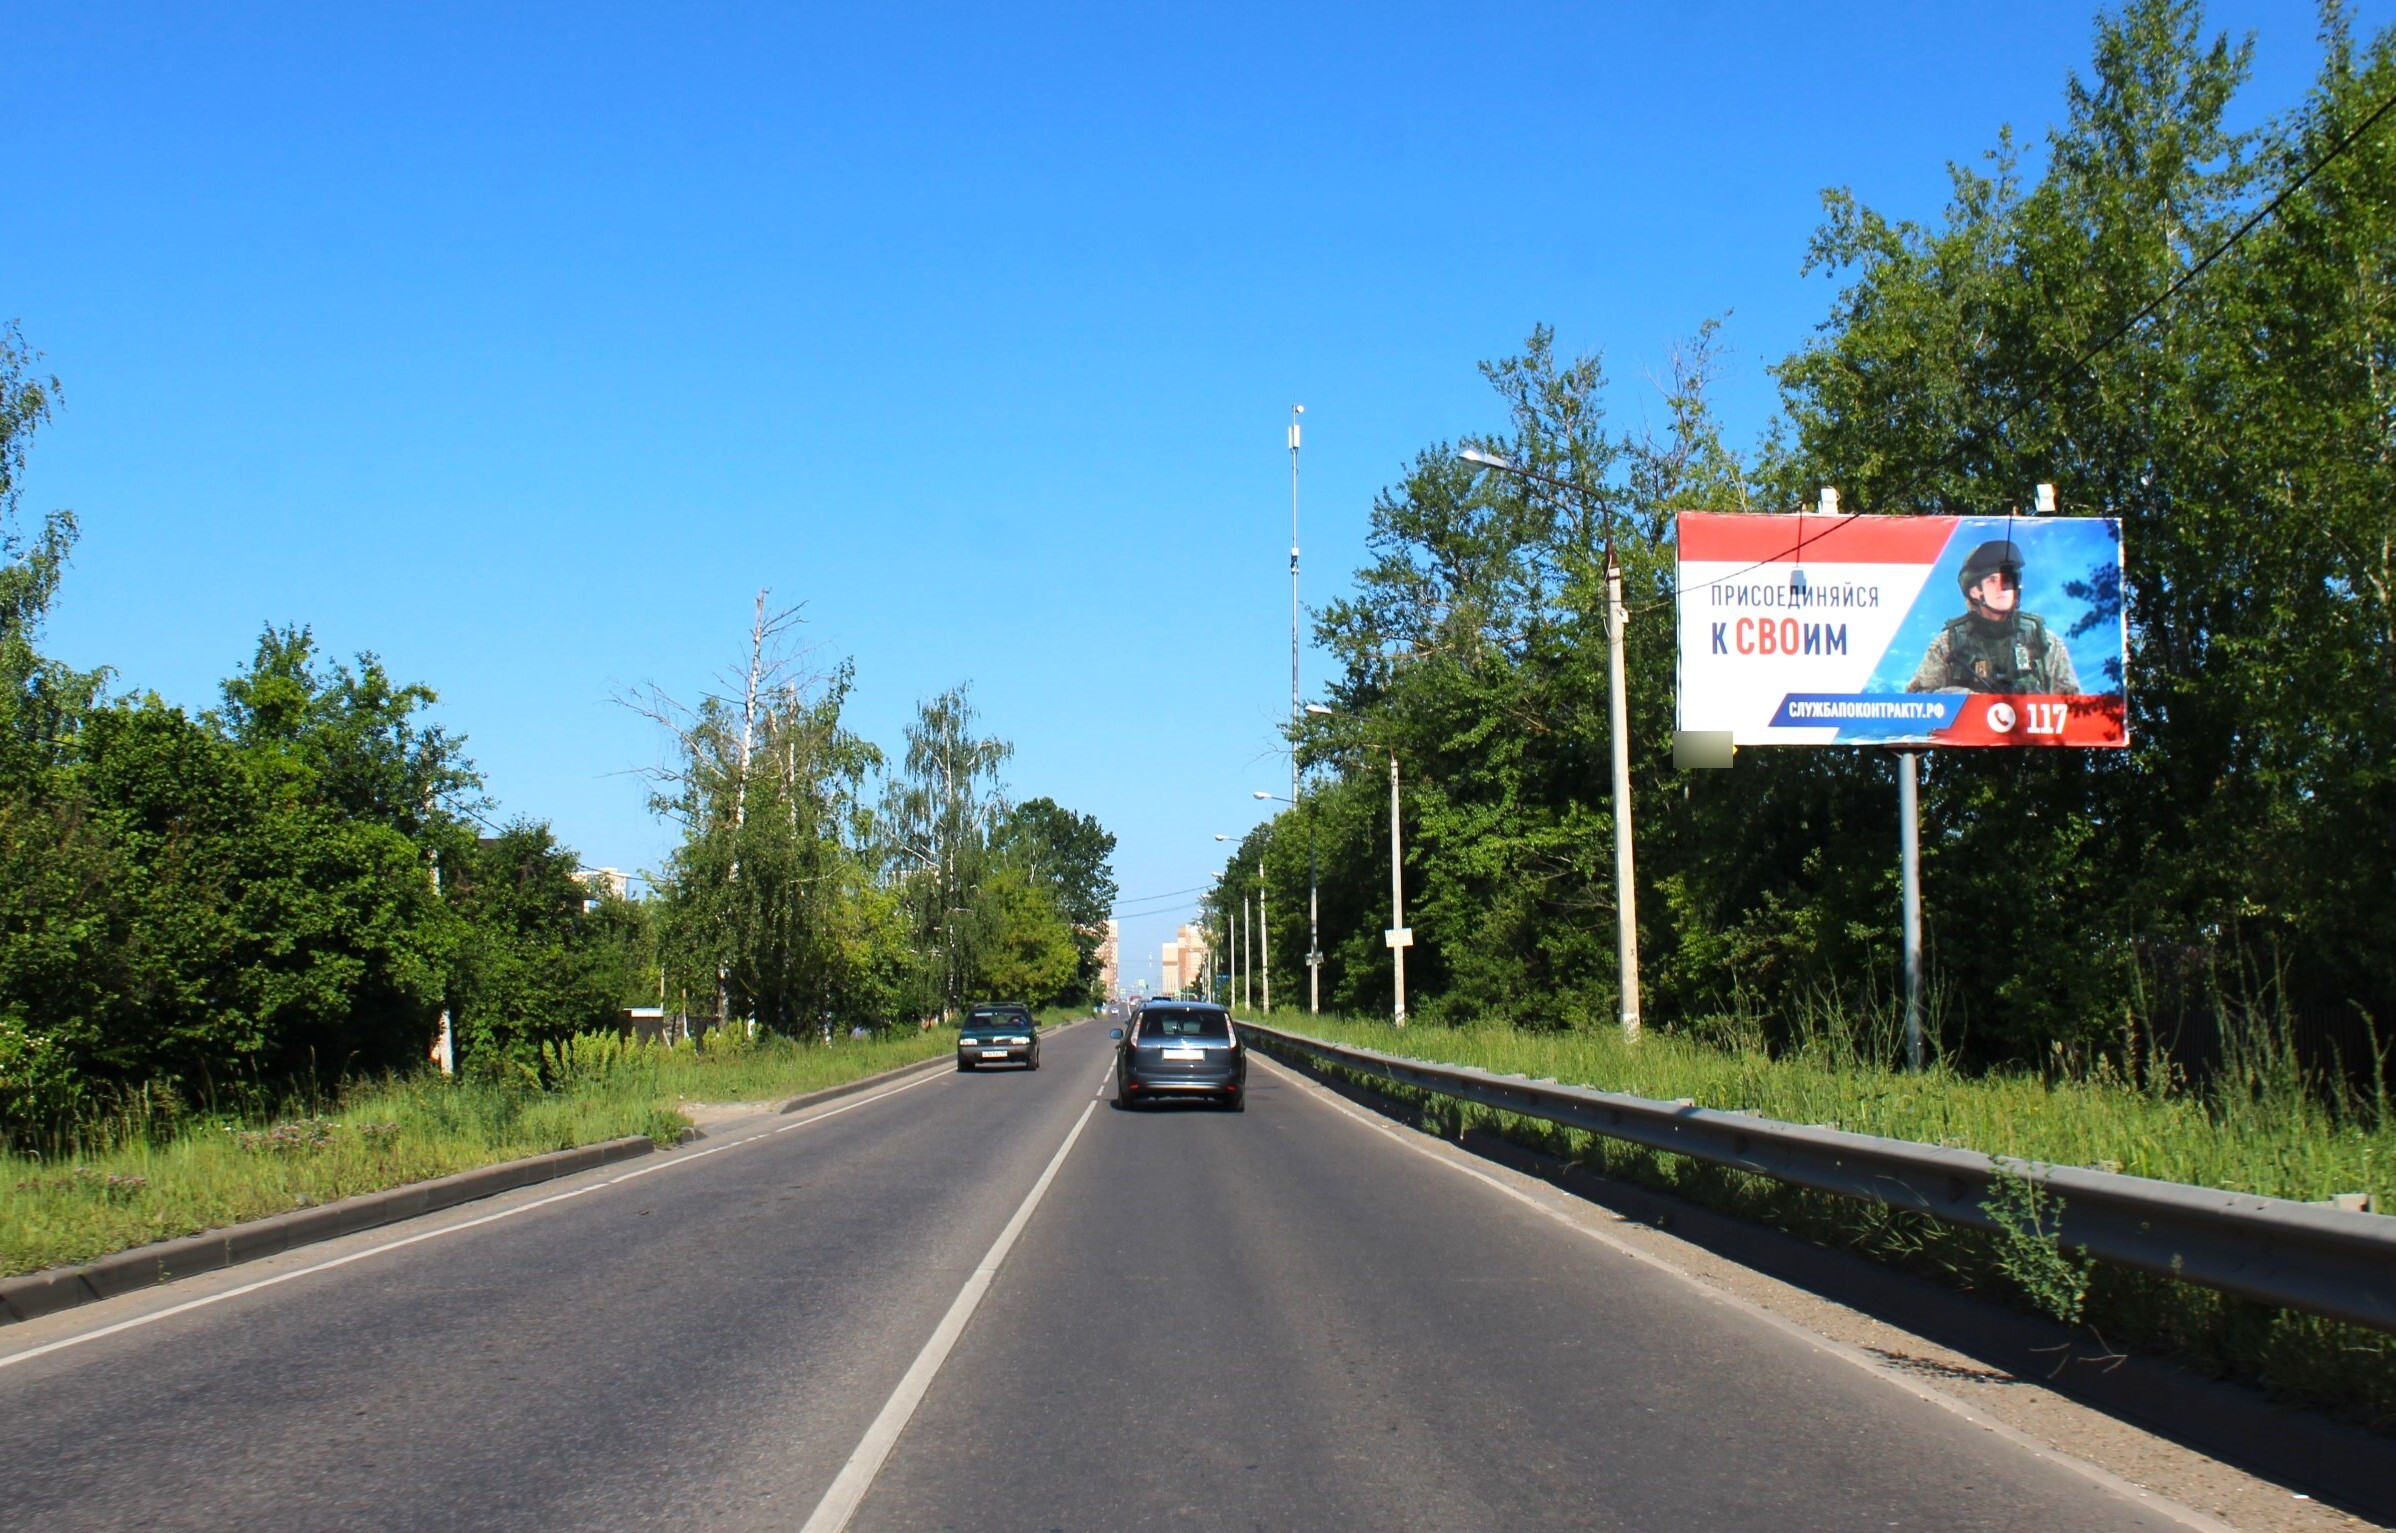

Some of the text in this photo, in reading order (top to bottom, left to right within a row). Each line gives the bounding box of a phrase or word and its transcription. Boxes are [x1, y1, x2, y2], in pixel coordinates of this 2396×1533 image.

[1711, 581, 1879, 609] ПРИСОЕДИНЯЙСЯ
[1712, 617, 1847, 655] К СВОИМ
[1788, 701, 1945, 719] СЛУЖБАПОКОНТРАКТУ.РФ
[2026, 704, 2068, 734] 117
